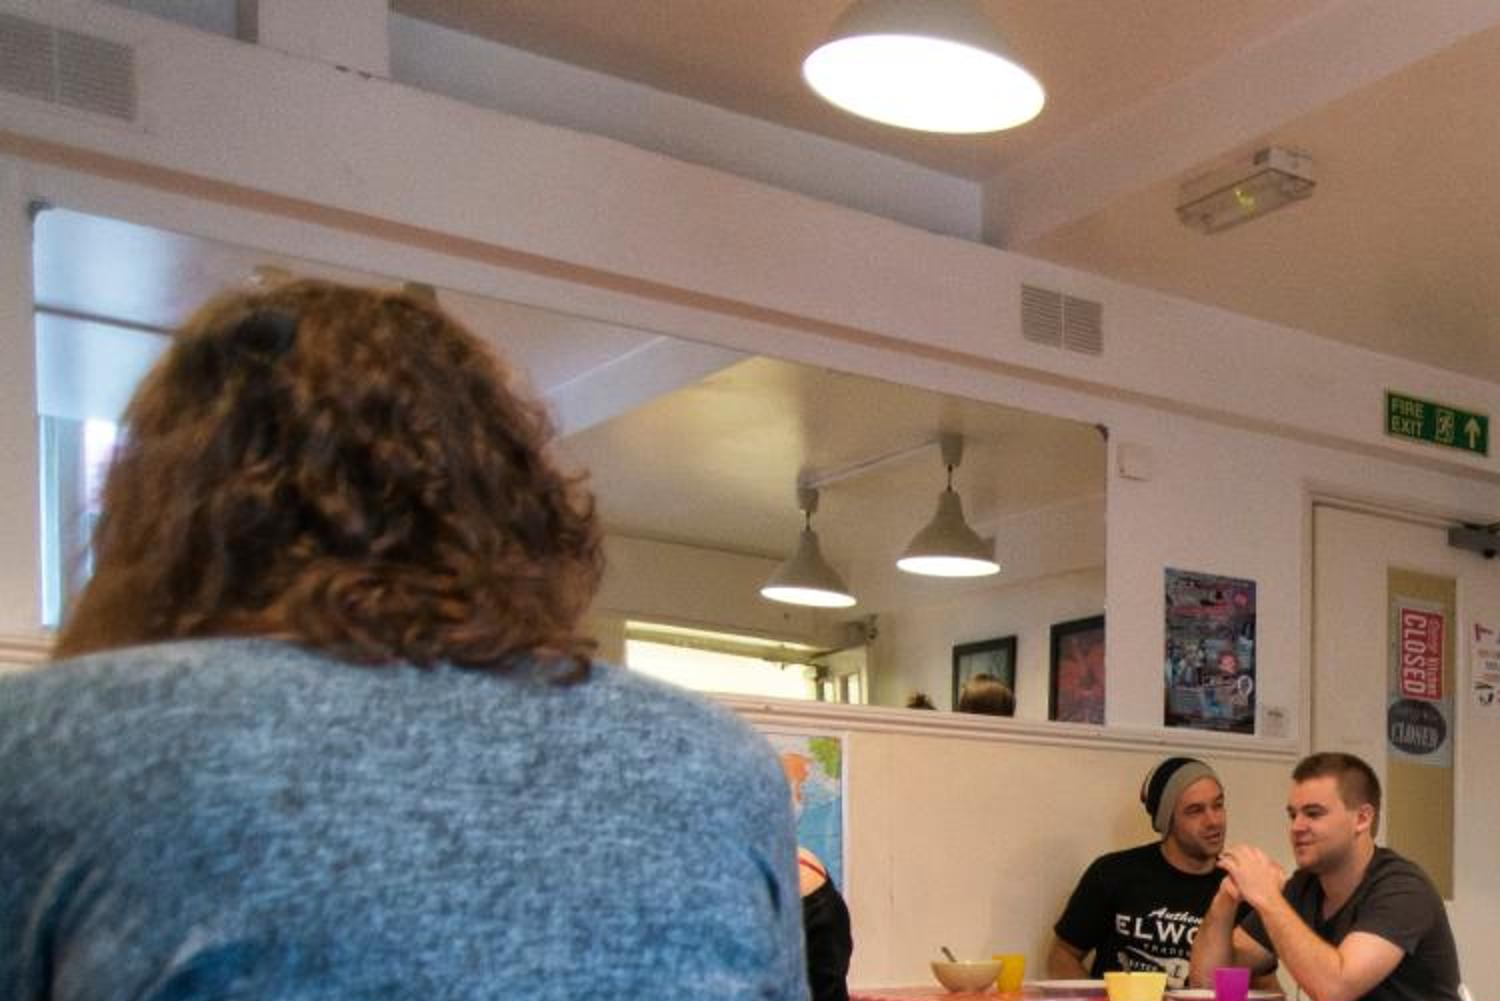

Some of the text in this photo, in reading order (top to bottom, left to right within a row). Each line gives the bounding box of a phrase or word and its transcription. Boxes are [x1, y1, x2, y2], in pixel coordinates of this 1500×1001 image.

[1391, 398, 1424, 417] FIRE
[1391, 416, 1424, 437] EXIT
[1403, 613, 1427, 694] CLOSED
